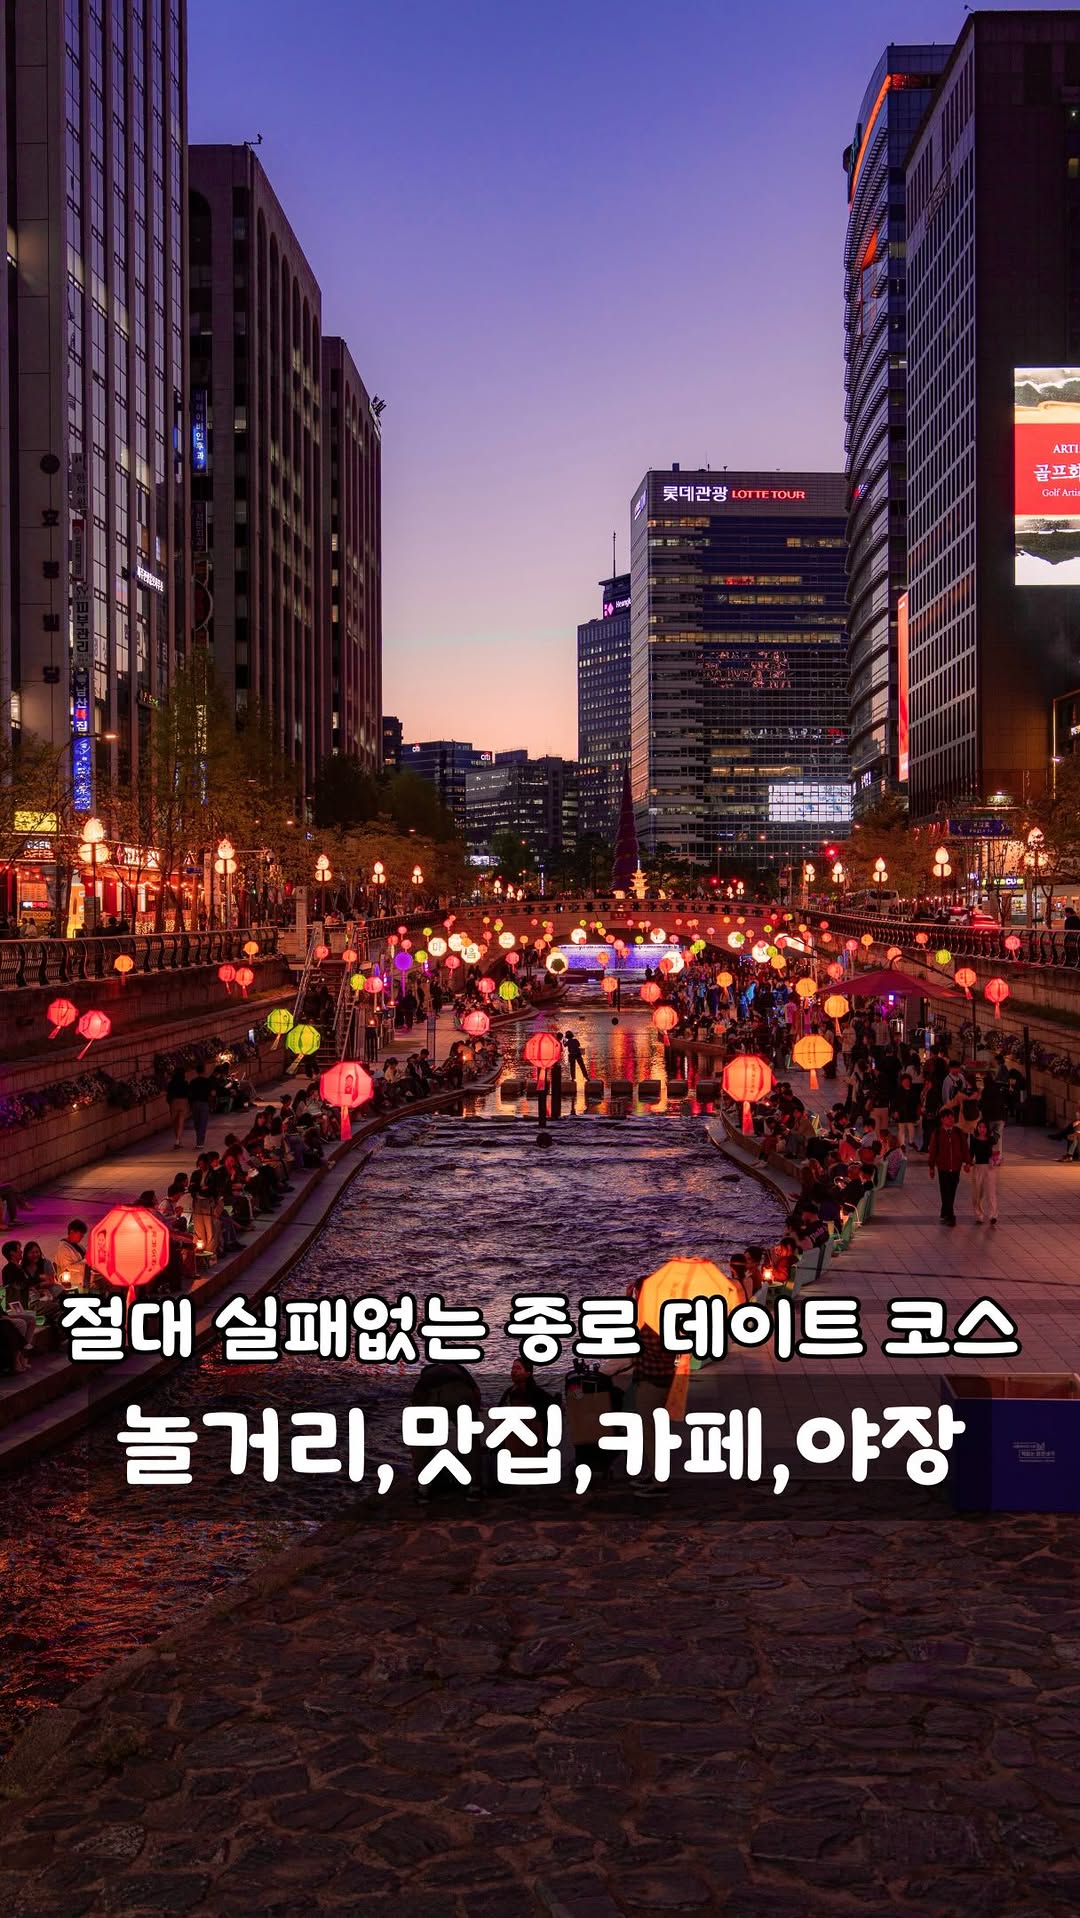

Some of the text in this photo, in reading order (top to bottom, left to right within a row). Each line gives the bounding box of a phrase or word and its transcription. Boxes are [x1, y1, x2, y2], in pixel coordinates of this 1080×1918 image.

[663, 486, 729, 502] 롯데관광
[731, 490, 806, 499] LOTTE TOUR
[1042, 488, 1060, 497] Golf
